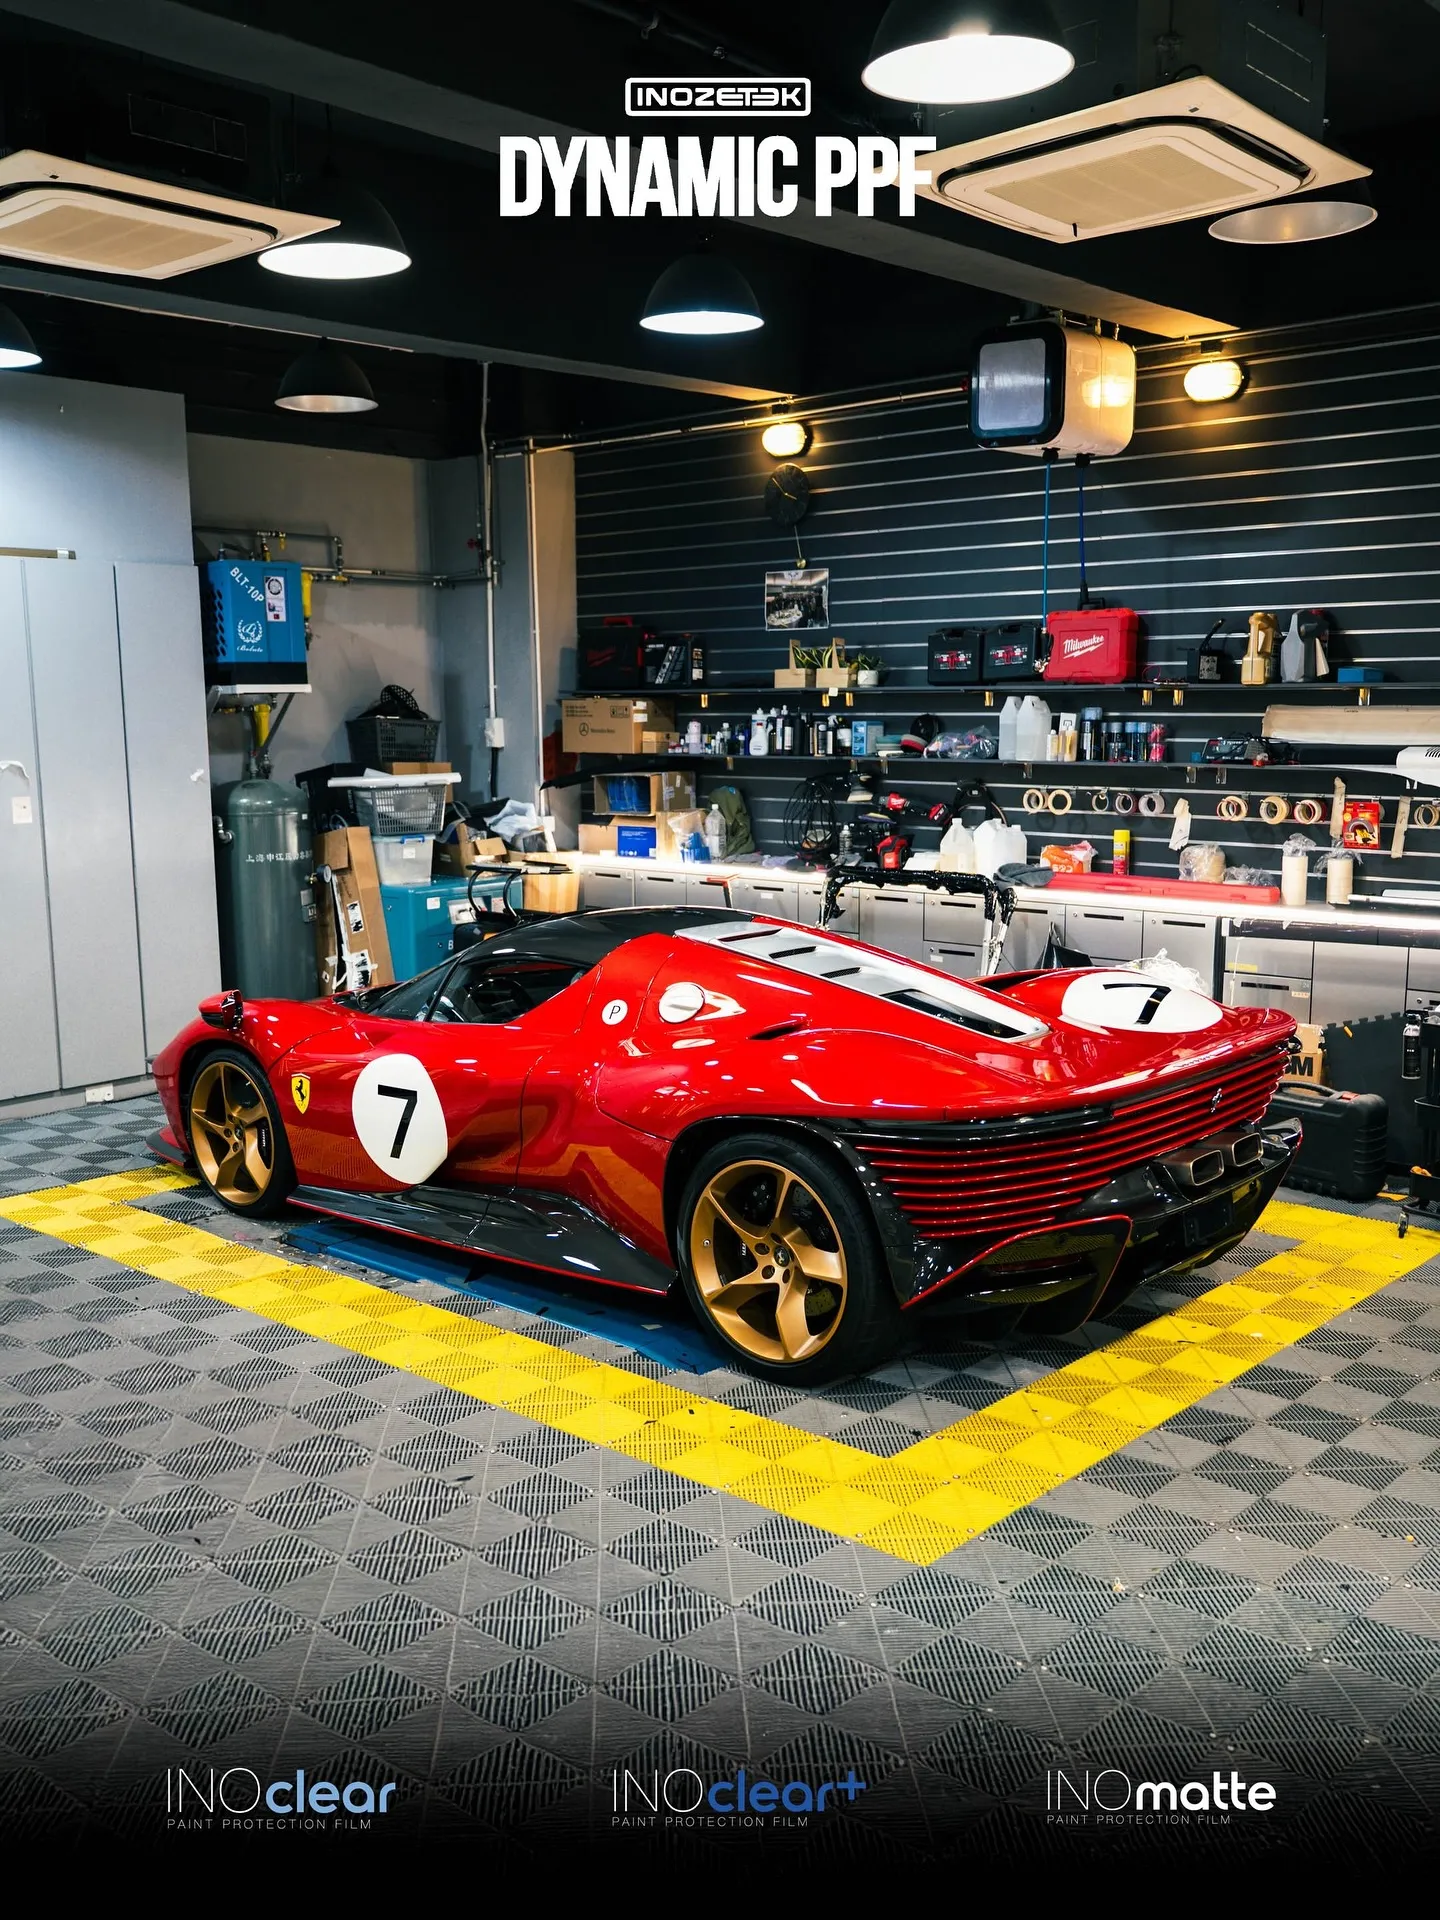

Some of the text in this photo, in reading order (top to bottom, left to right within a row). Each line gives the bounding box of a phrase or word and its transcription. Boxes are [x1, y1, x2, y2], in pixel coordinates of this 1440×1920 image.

[230, 566, 265, 602] BLT-10P
[1063, 634, 1105, 654] Milwaukee
[609, 1005, 621, 1020] P
[1102, 983, 1172, 1025] 7
[377, 1083, 418, 1160] 7
